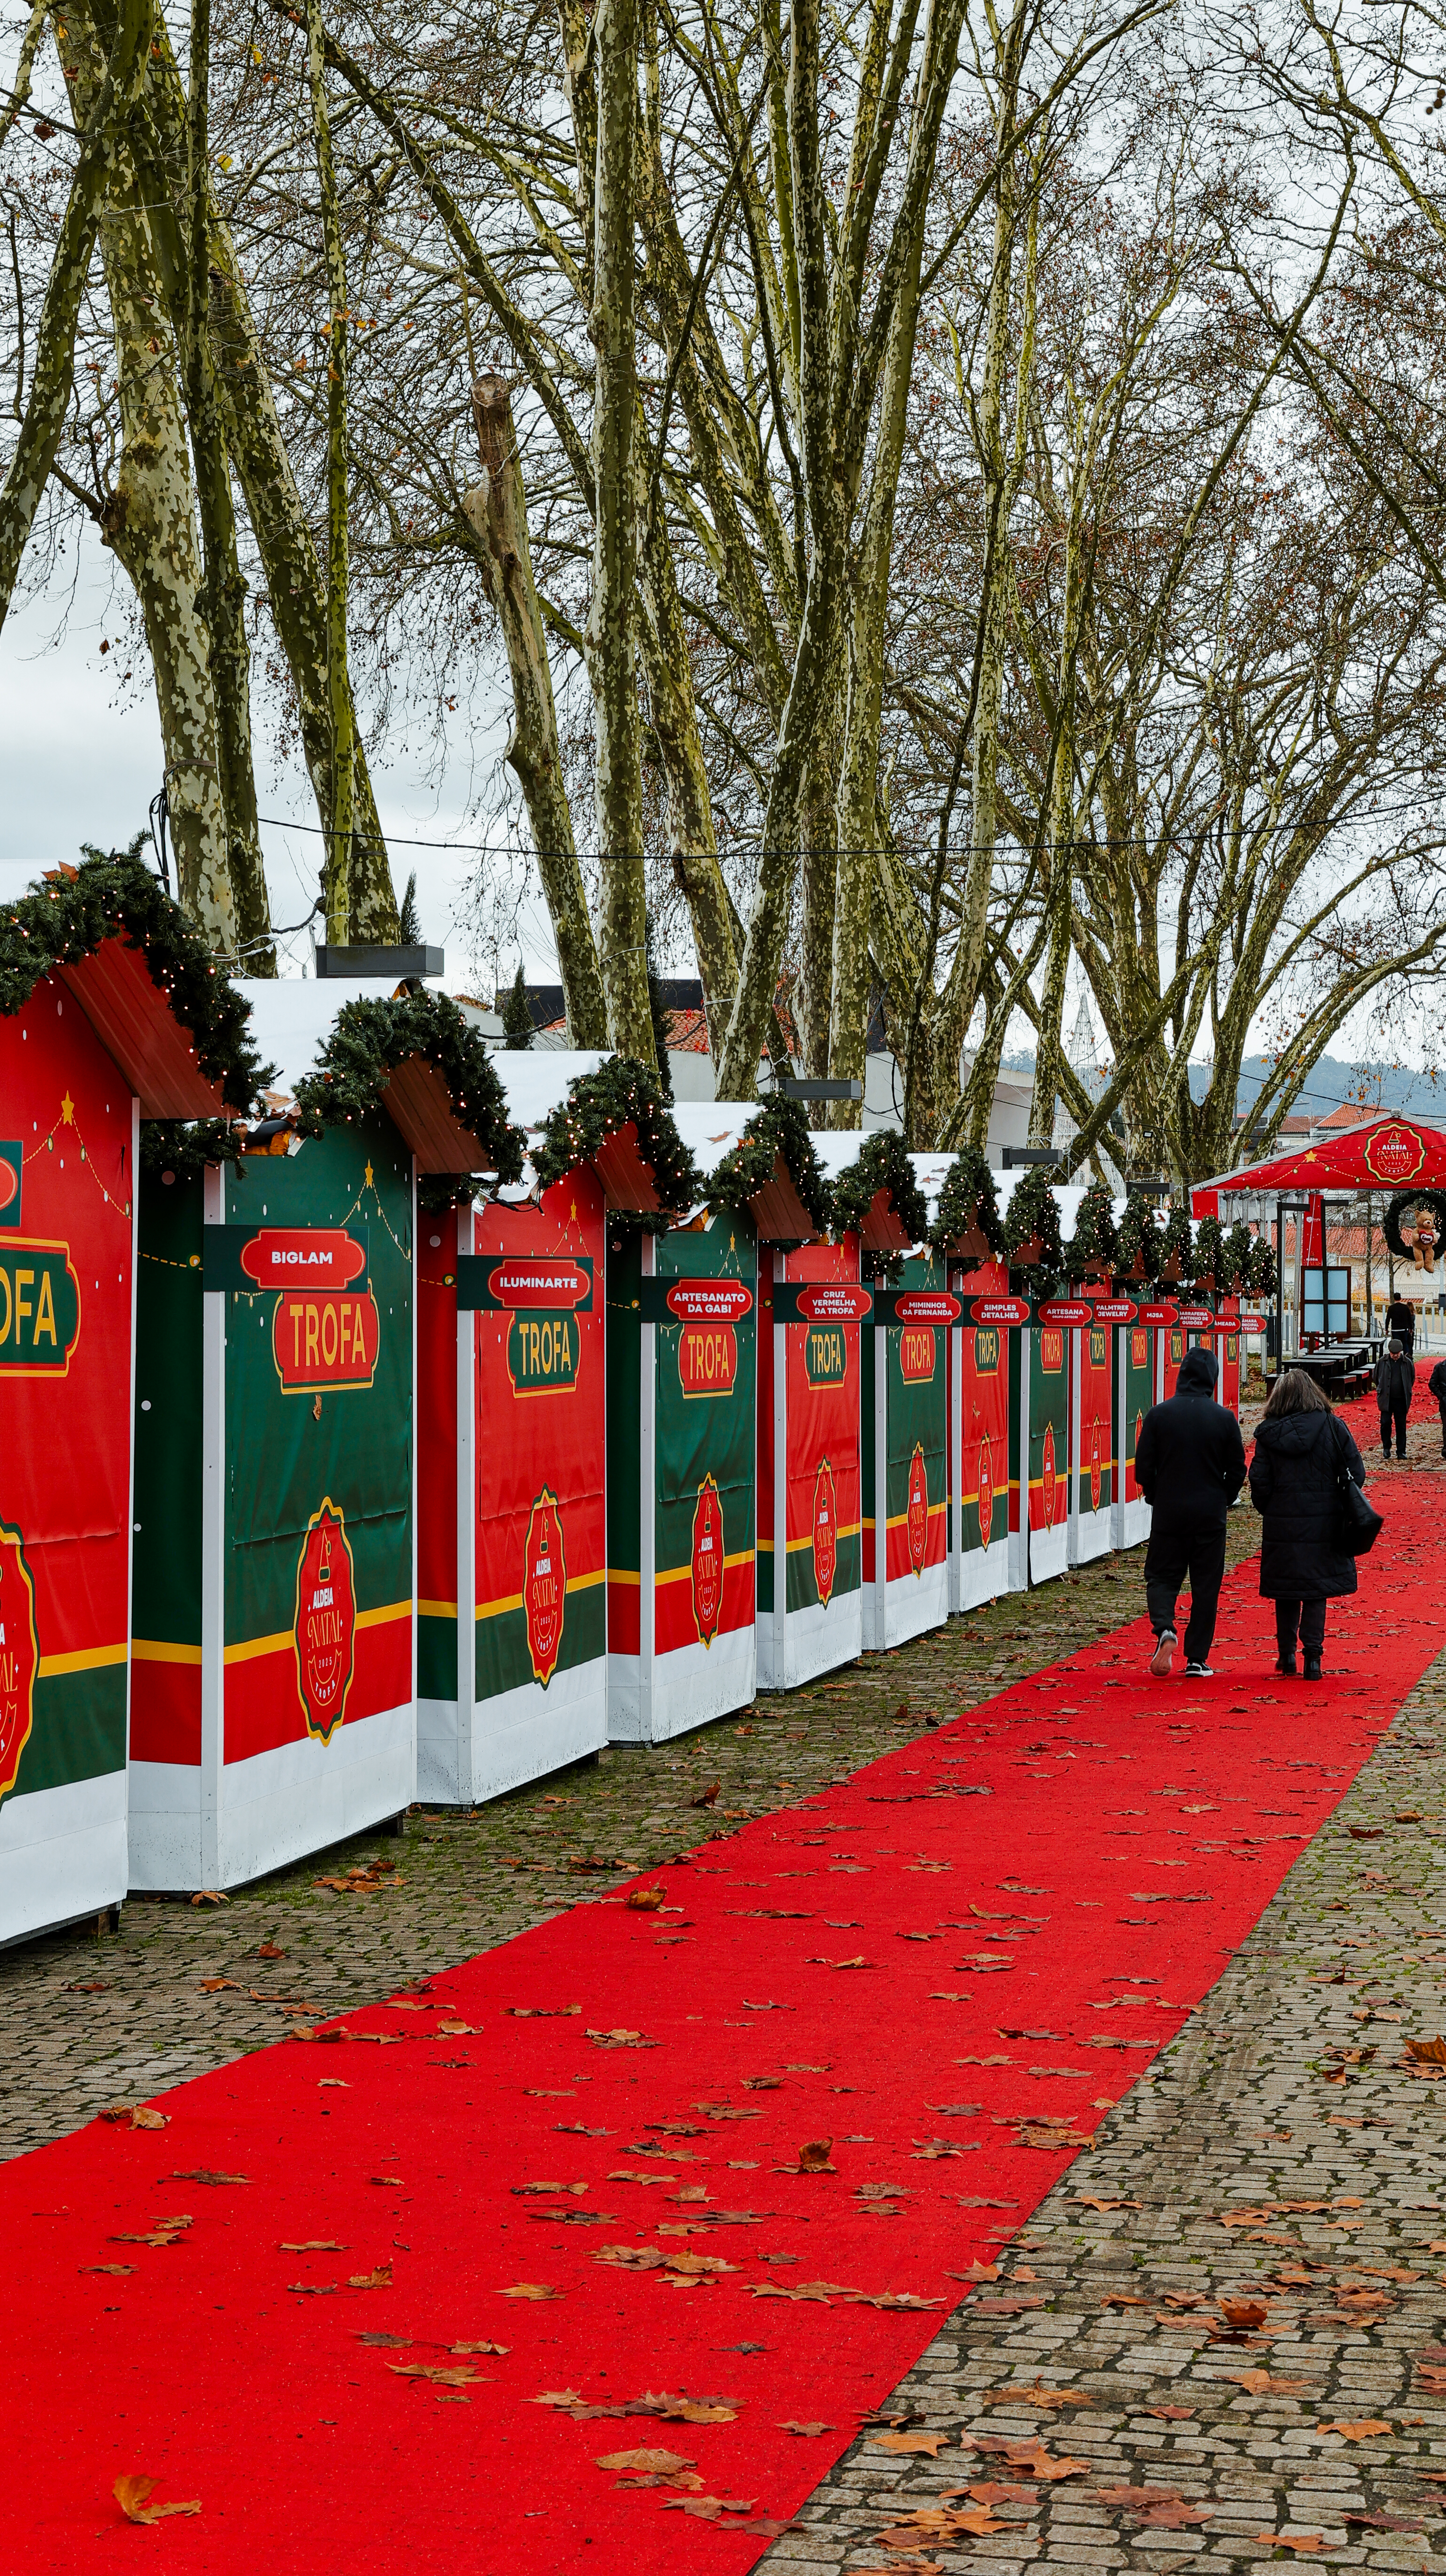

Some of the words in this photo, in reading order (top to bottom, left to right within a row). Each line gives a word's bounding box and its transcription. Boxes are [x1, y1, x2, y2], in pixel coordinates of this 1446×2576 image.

[1377, 1151, 1412, 1159] NATAL
[272, 1251, 333, 1264] BIGLAM
[500, 1277, 578, 1288] ILUMINARTE
[674, 1293, 746, 1303] ARTESANATO
[688, 1304, 703, 1313] DA
[705, 1304, 731, 1313] GABI
[290, 1303, 366, 1367] TROFA
[1092, 1333, 1105, 1360] TROFA
[519, 1321, 571, 1376] TROFA
[688, 1334, 729, 1380] TROFA
[811, 1334, 841, 1374] TROFA
[906, 1334, 931, 1370] TROFA
[978, 1332, 996, 1364] TROFA
[1044, 1333, 1060, 1362] TROFA
[701, 1537, 713, 1552] ALDEIA
[536, 1558, 551, 1577] ALDEIA
[699, 1553, 717, 1580] NATAL
[313, 1587, 334, 1610] ALDEIA
[532, 1577, 557, 1609] NATAL
[307, 1610, 342, 1649] NATAL
[540, 1616, 550, 1626] 2025
[538, 1634, 552, 1651] TROFA
[319, 1656, 332, 1668] 2025
[315, 1679, 336, 1699] TROFA
